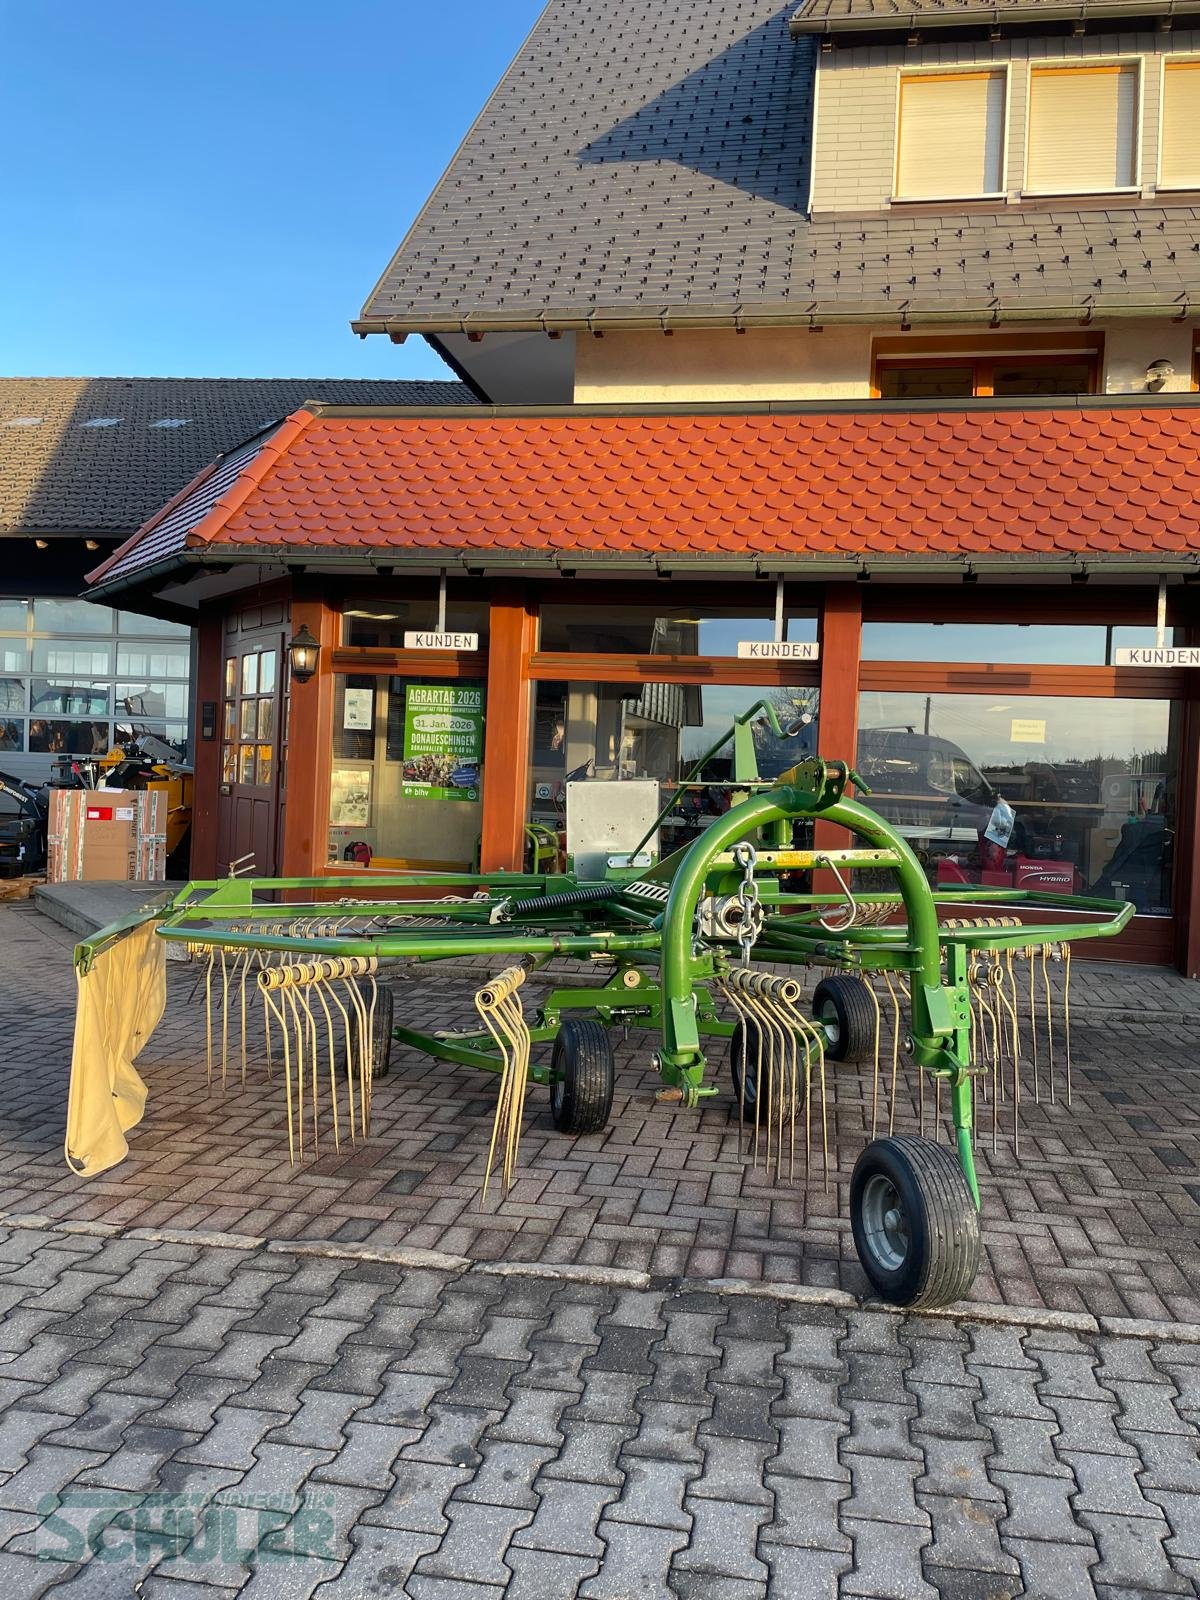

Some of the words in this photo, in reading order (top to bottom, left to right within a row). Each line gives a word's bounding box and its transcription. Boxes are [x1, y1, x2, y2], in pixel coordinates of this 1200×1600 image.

[416, 634, 472, 648] KUNDEN
[750, 644, 812, 657] KUNDEN
[1130, 650, 1200, 664] KUNDEN
[409, 689, 455, 703] AGRARTAG
[458, 691, 480, 705] 2026
[415, 720, 428, 728] 31.
[430, 720, 448, 729] Jan.
[450, 721, 472, 729] 2026
[411, 733, 475, 746] DONAUESCHINGEN
[414, 788, 429, 796] blhv
